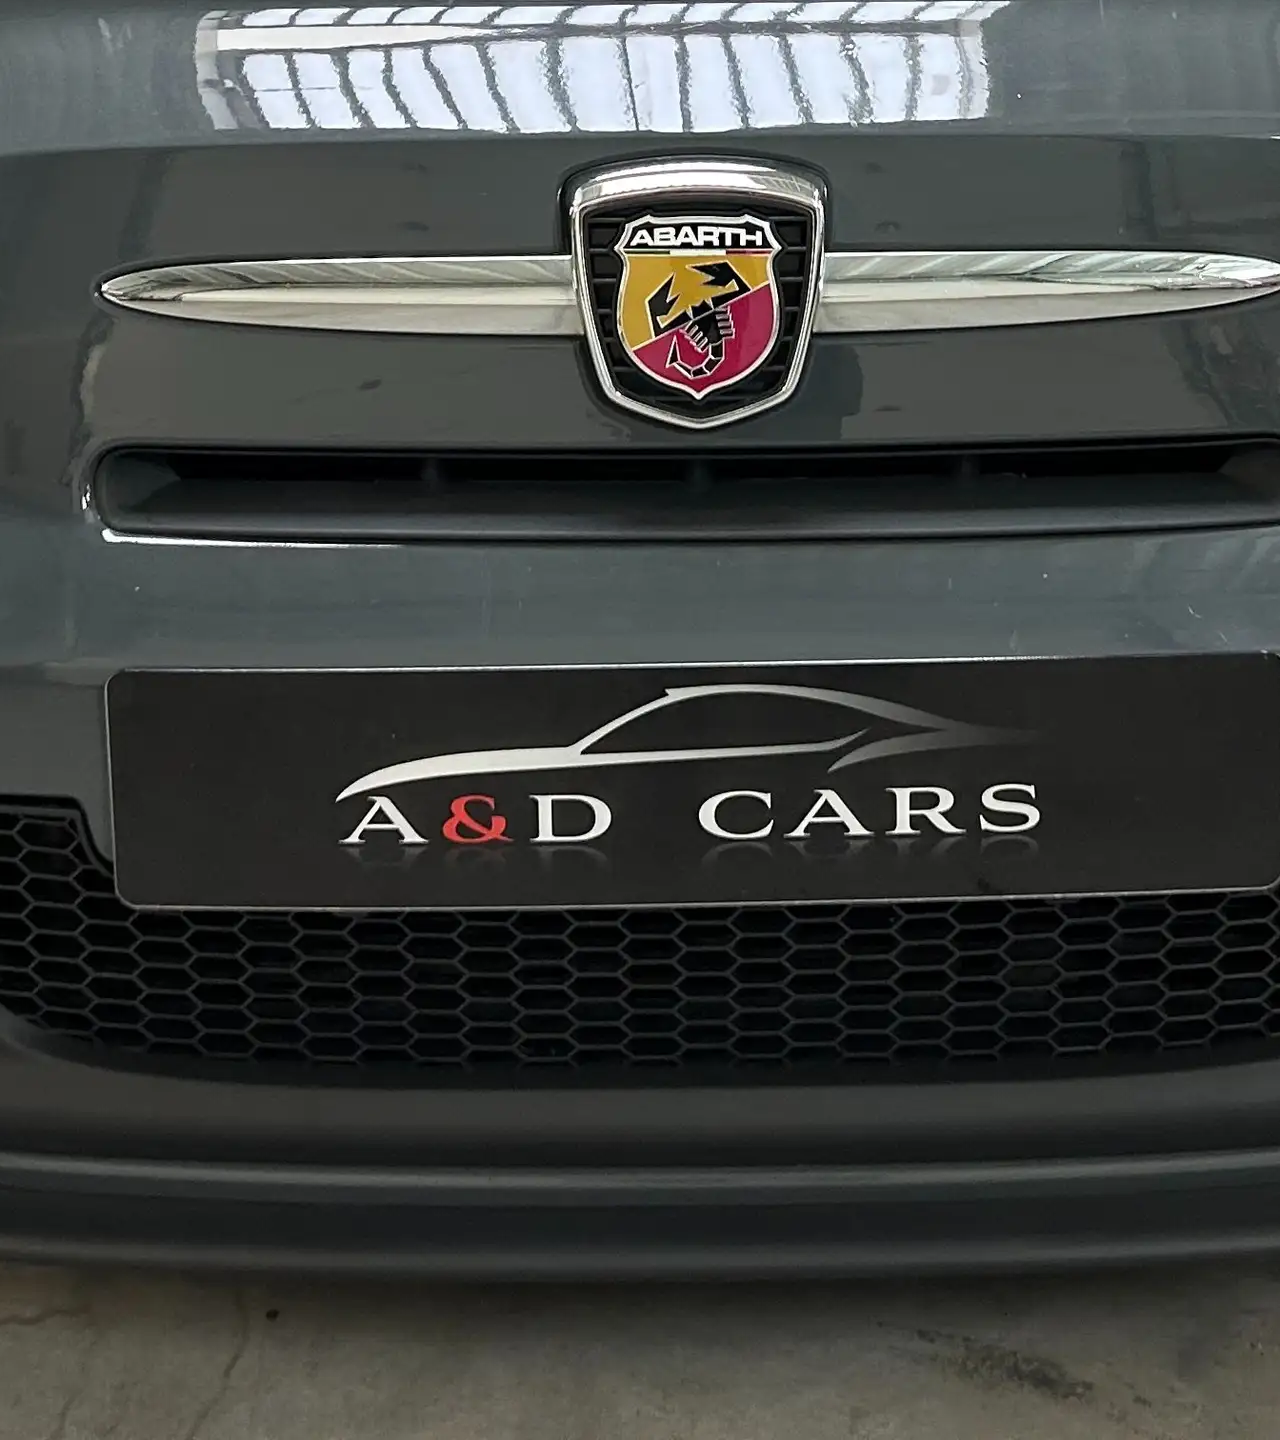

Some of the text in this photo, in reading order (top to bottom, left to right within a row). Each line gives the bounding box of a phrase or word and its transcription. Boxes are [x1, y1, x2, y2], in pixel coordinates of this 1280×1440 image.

[630, 226, 763, 247] ABARTH
[338, 784, 1042, 844] A&D CARS
